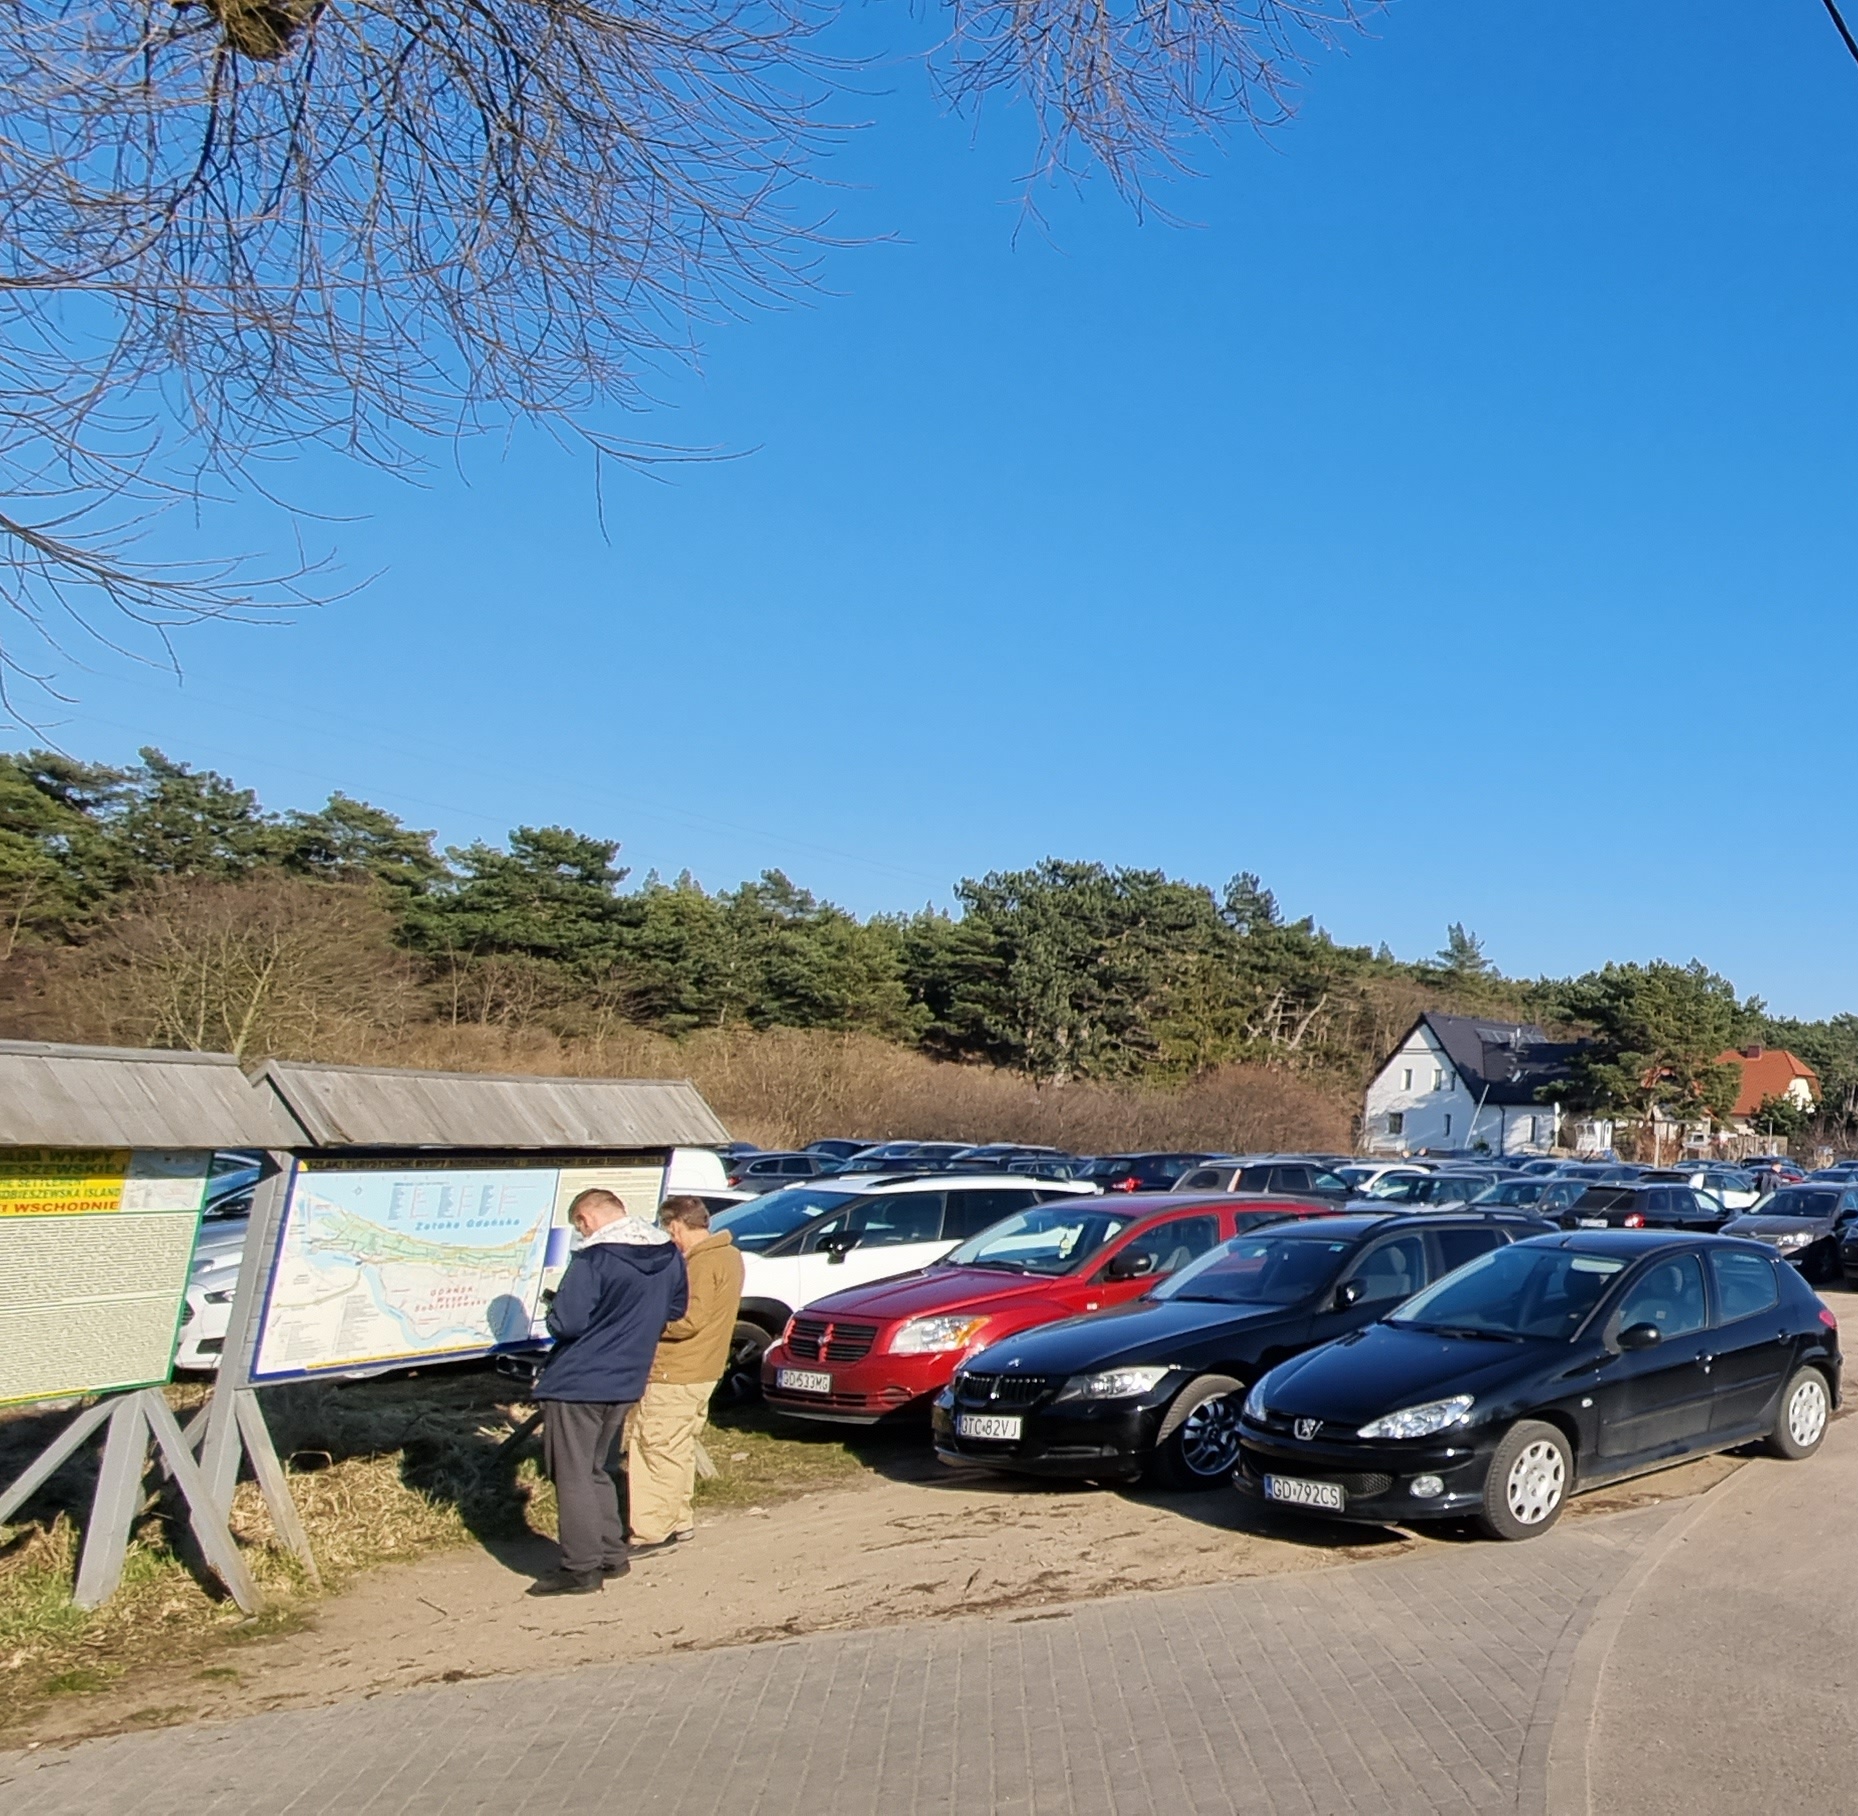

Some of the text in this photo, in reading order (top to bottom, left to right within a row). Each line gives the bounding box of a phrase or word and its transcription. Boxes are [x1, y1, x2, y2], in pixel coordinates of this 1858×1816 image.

[14, 1201, 120, 1213] WSCHODNIE
[1274, 1479, 1338, 1506] GD 792CS
